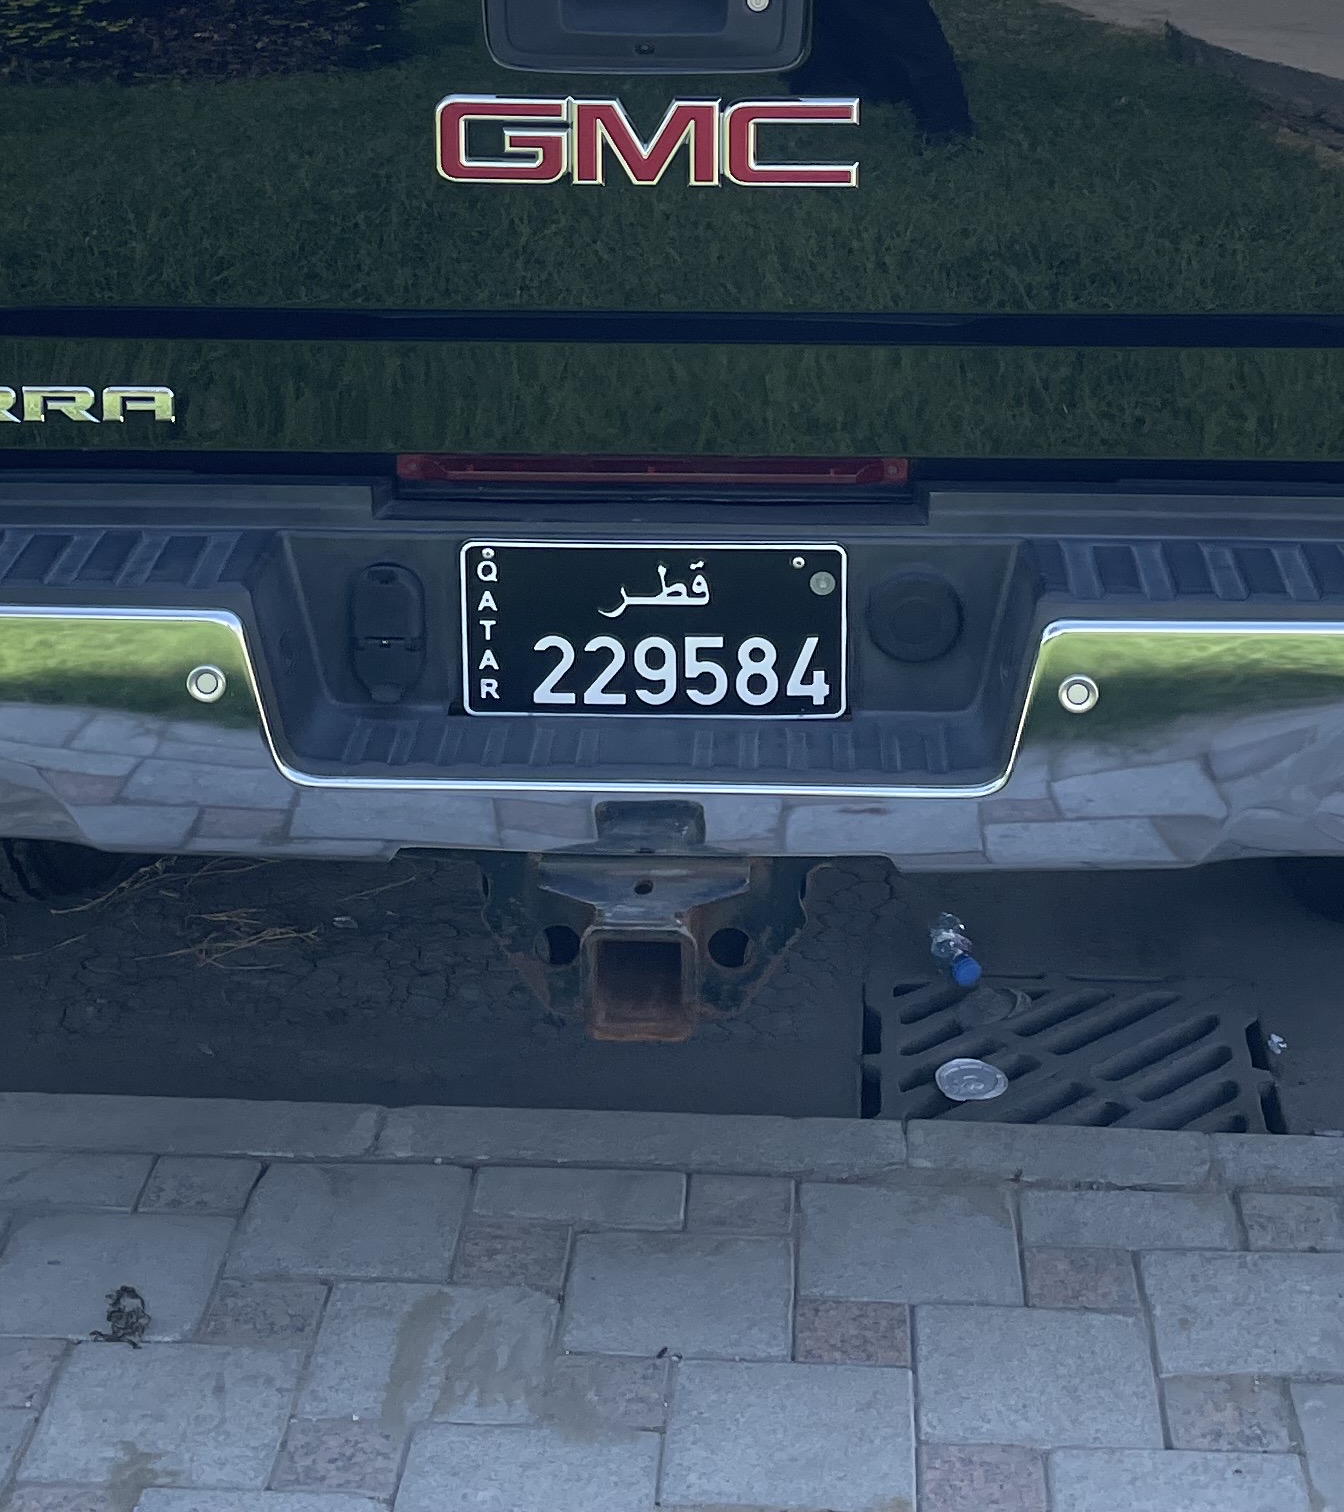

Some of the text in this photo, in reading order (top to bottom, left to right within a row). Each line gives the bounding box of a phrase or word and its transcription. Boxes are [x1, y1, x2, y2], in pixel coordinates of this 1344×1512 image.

[435, 93, 860, 187] GMC
[476, 559, 501, 701] QATAR
[597, 559, 711, 619] قطر
[532, 634, 831, 706] 229584
